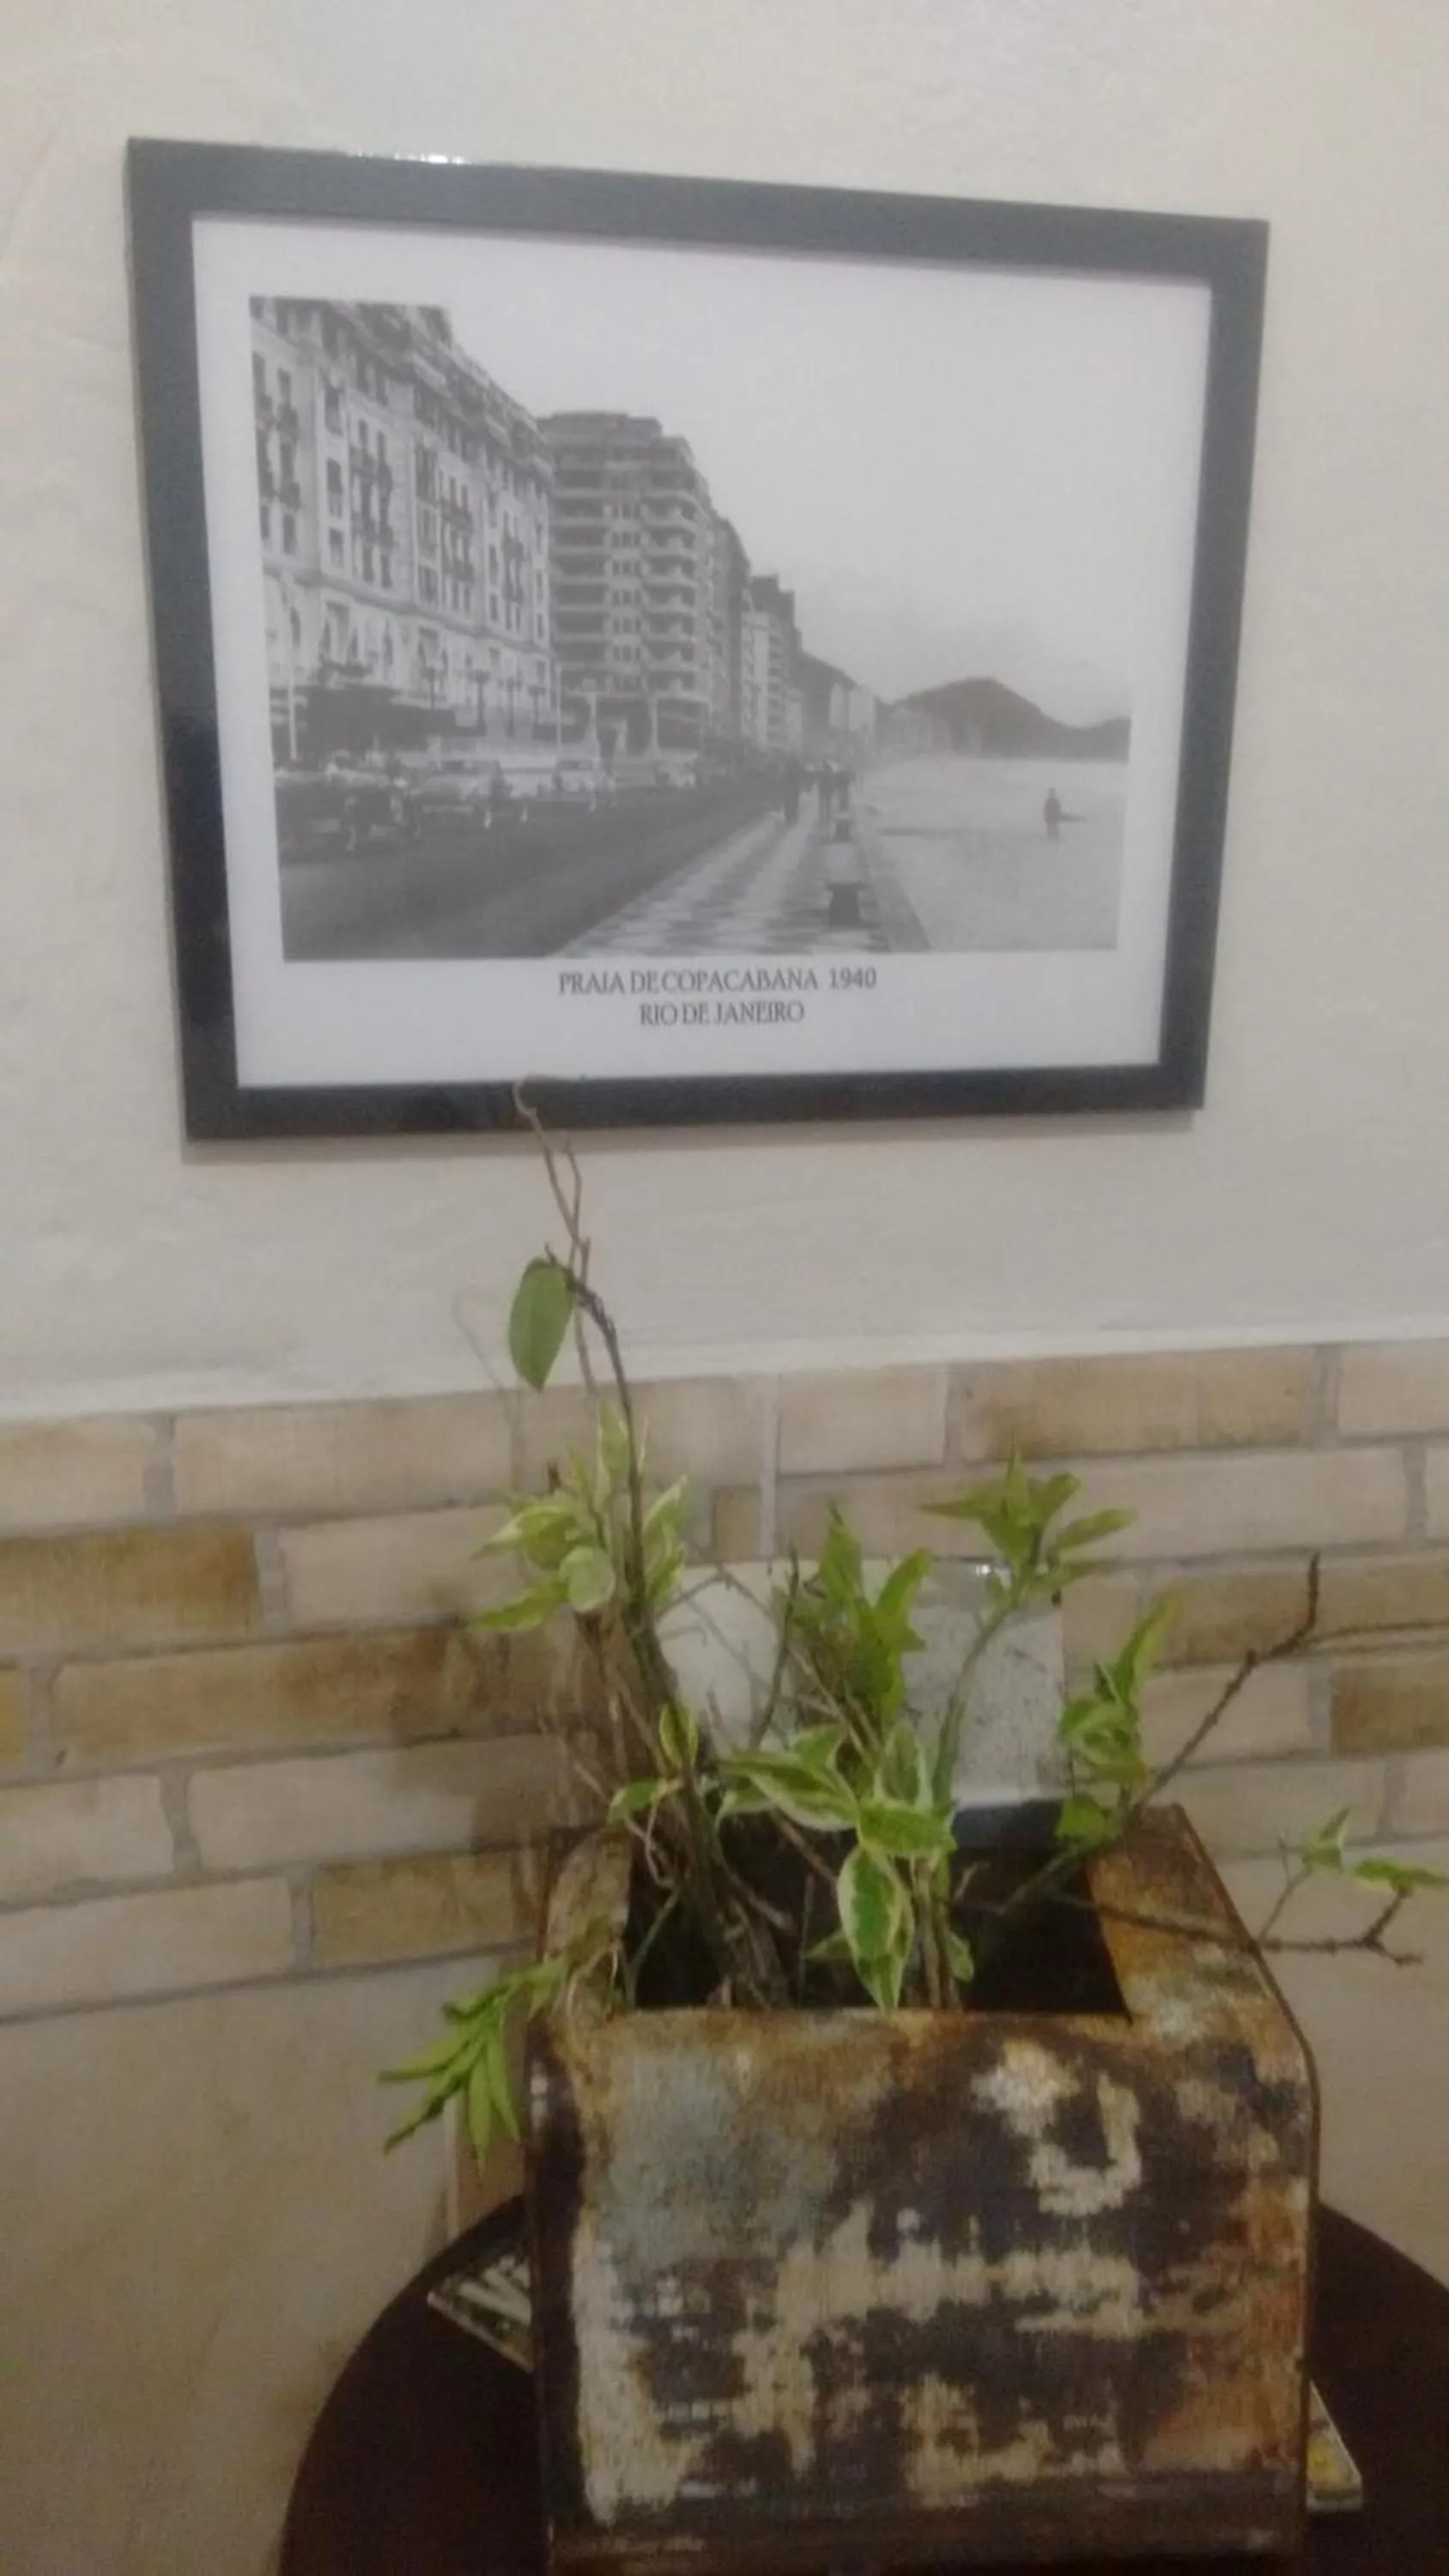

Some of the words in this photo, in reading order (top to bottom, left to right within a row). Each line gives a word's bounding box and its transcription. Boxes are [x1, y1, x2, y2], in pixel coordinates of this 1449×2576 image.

[559, 970, 625, 995] PRAIA
[630, 969, 659, 993] DE
[662, 968, 819, 993] COPACABANA
[828, 966, 877, 990] 1940
[640, 1002, 677, 1026] RIO
[682, 1002, 710, 1025] DE
[713, 1000, 805, 1025] JANEIRO
